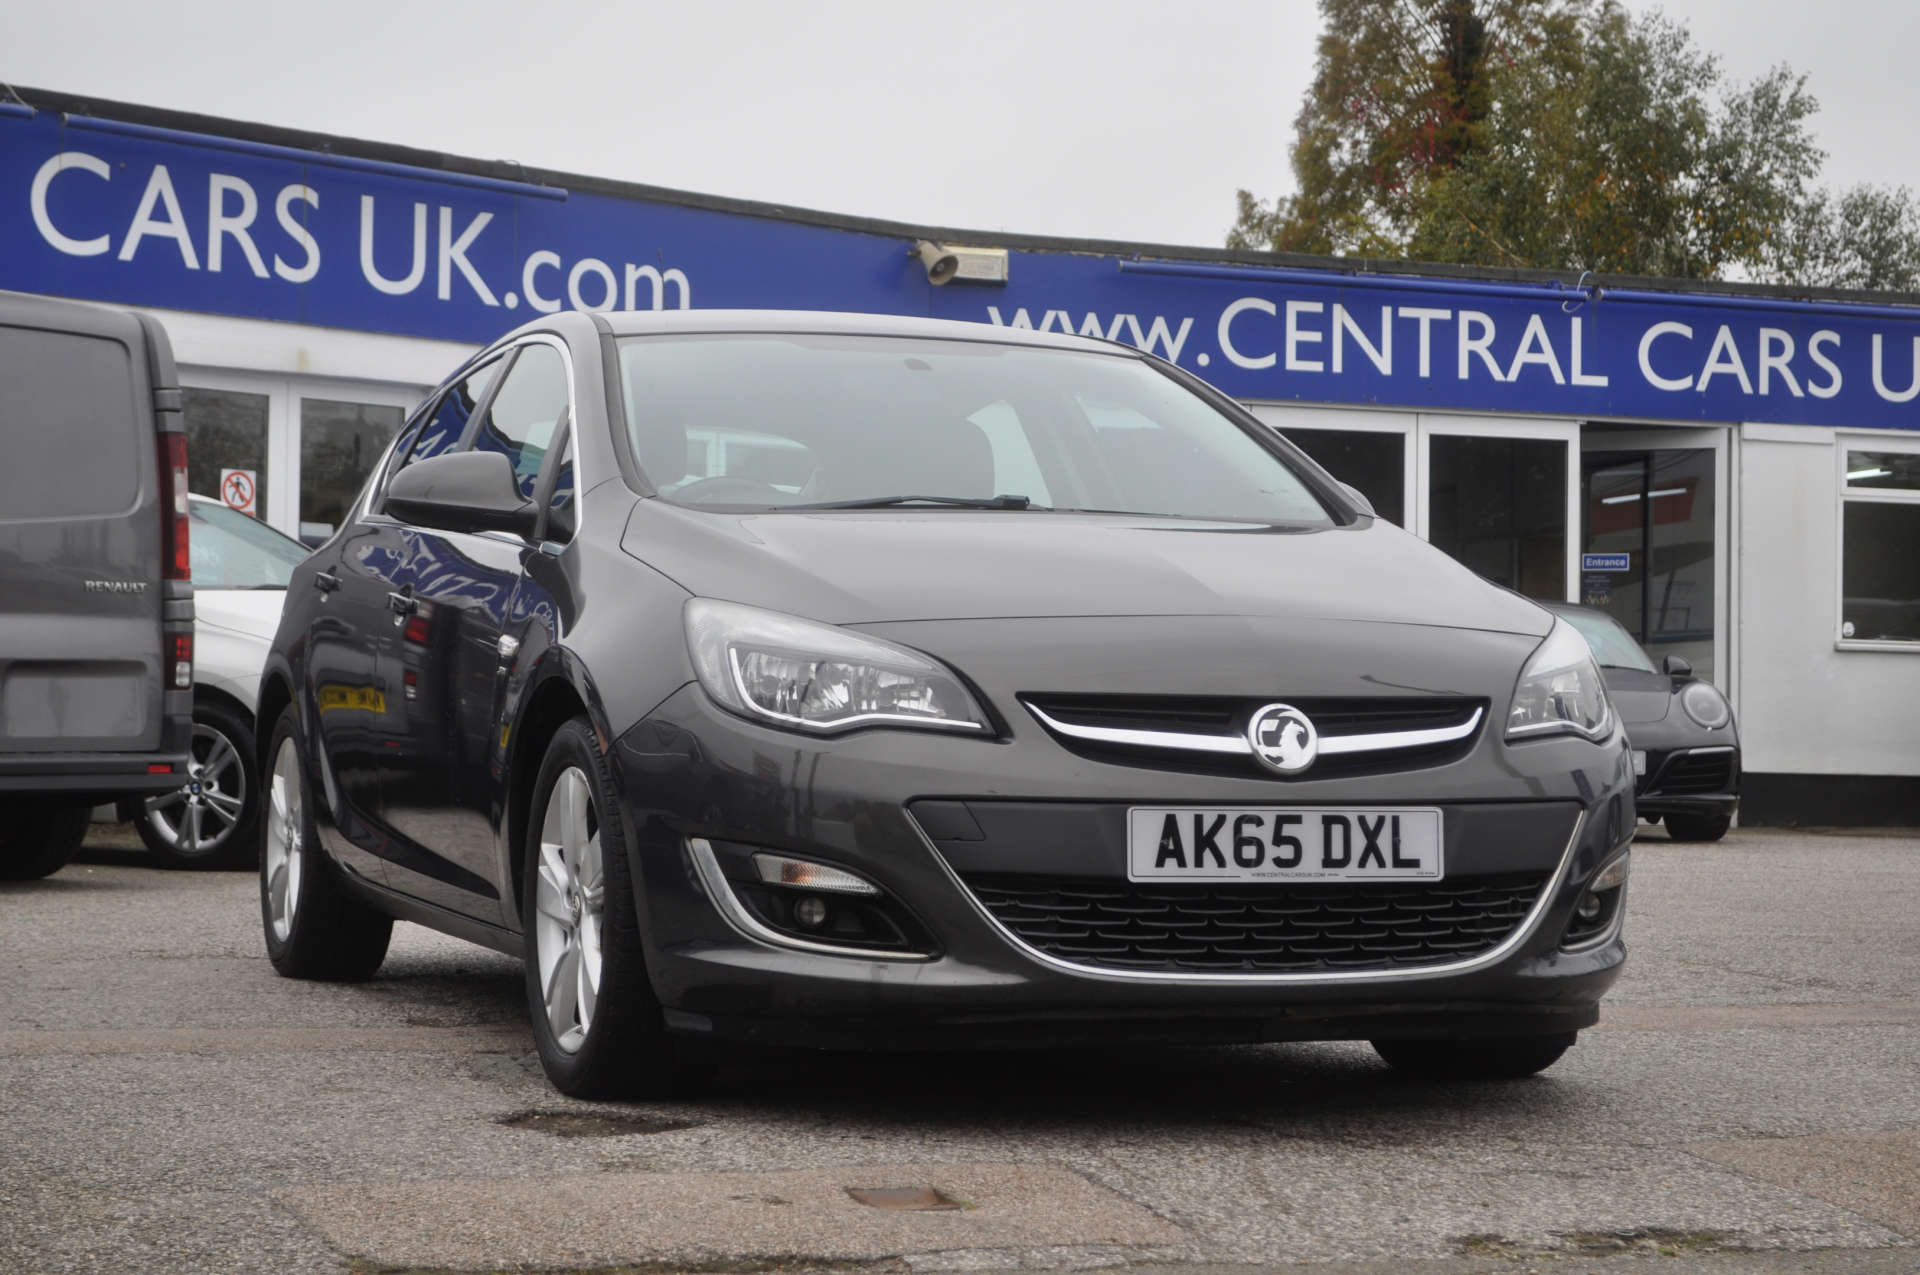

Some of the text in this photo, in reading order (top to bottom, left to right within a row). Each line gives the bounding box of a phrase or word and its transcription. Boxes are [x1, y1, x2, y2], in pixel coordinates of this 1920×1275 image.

[30, 151, 690, 314] CARS UK.com
[1638, 321, 1843, 398] CARS
[85, 580, 147, 592] RENAULT
[1585, 557, 1626, 567] Entrance
[1155, 813, 1420, 868] AK65 DXL
